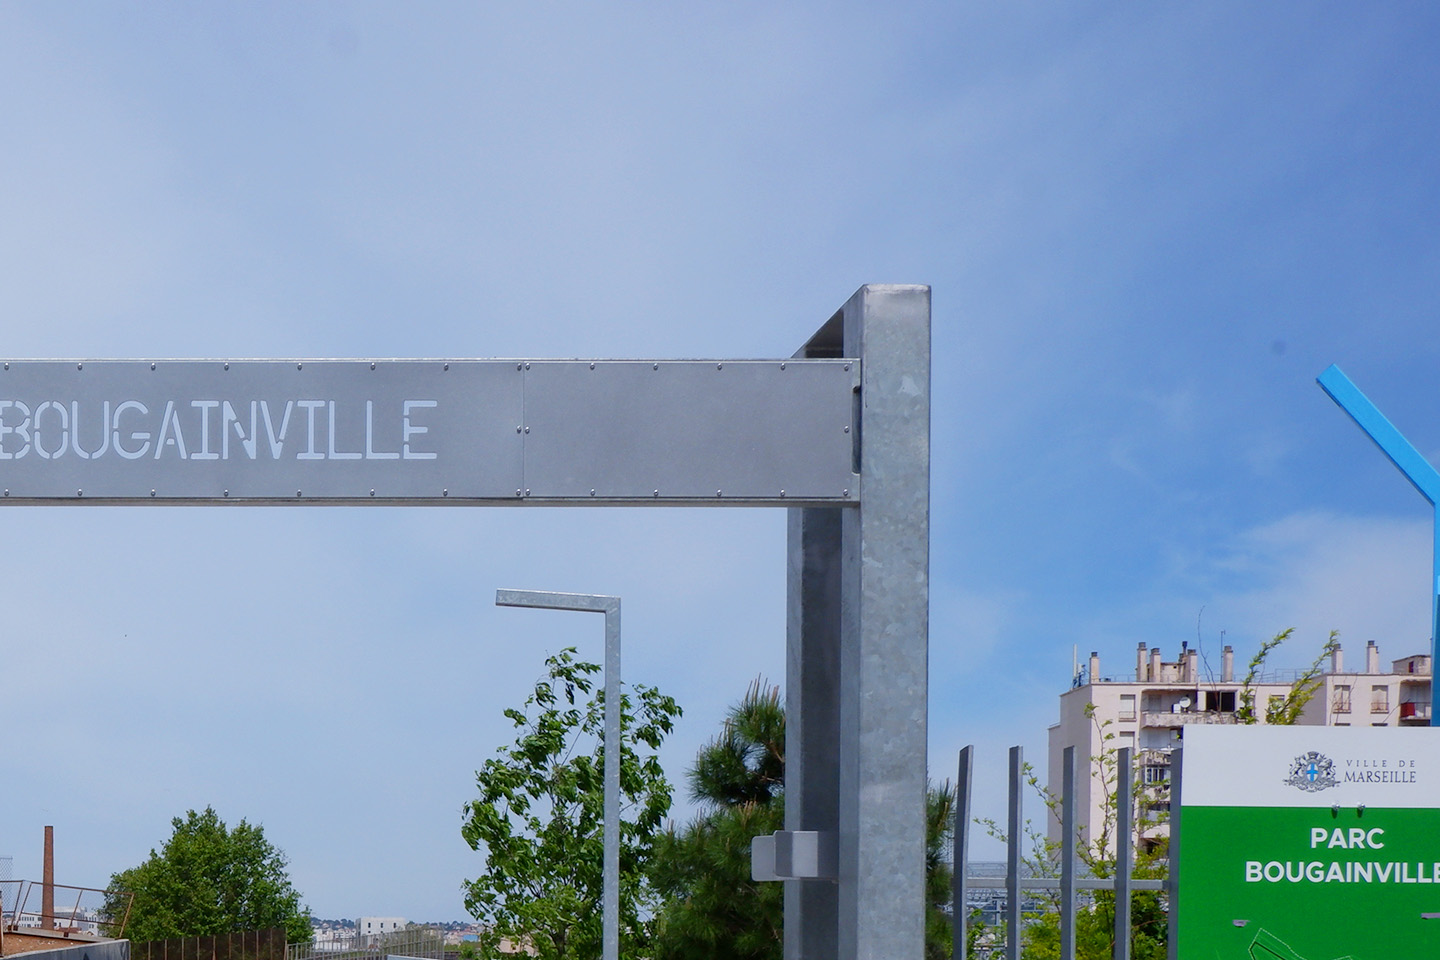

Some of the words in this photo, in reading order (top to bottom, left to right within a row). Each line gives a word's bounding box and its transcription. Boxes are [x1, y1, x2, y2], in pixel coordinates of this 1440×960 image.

[1346, 760, 1387, 768] VILLE
[1398, 760, 1416, 768] DE
[1344, 771, 1417, 783] MARSEILLE
[1310, 827, 1385, 849] PARC
